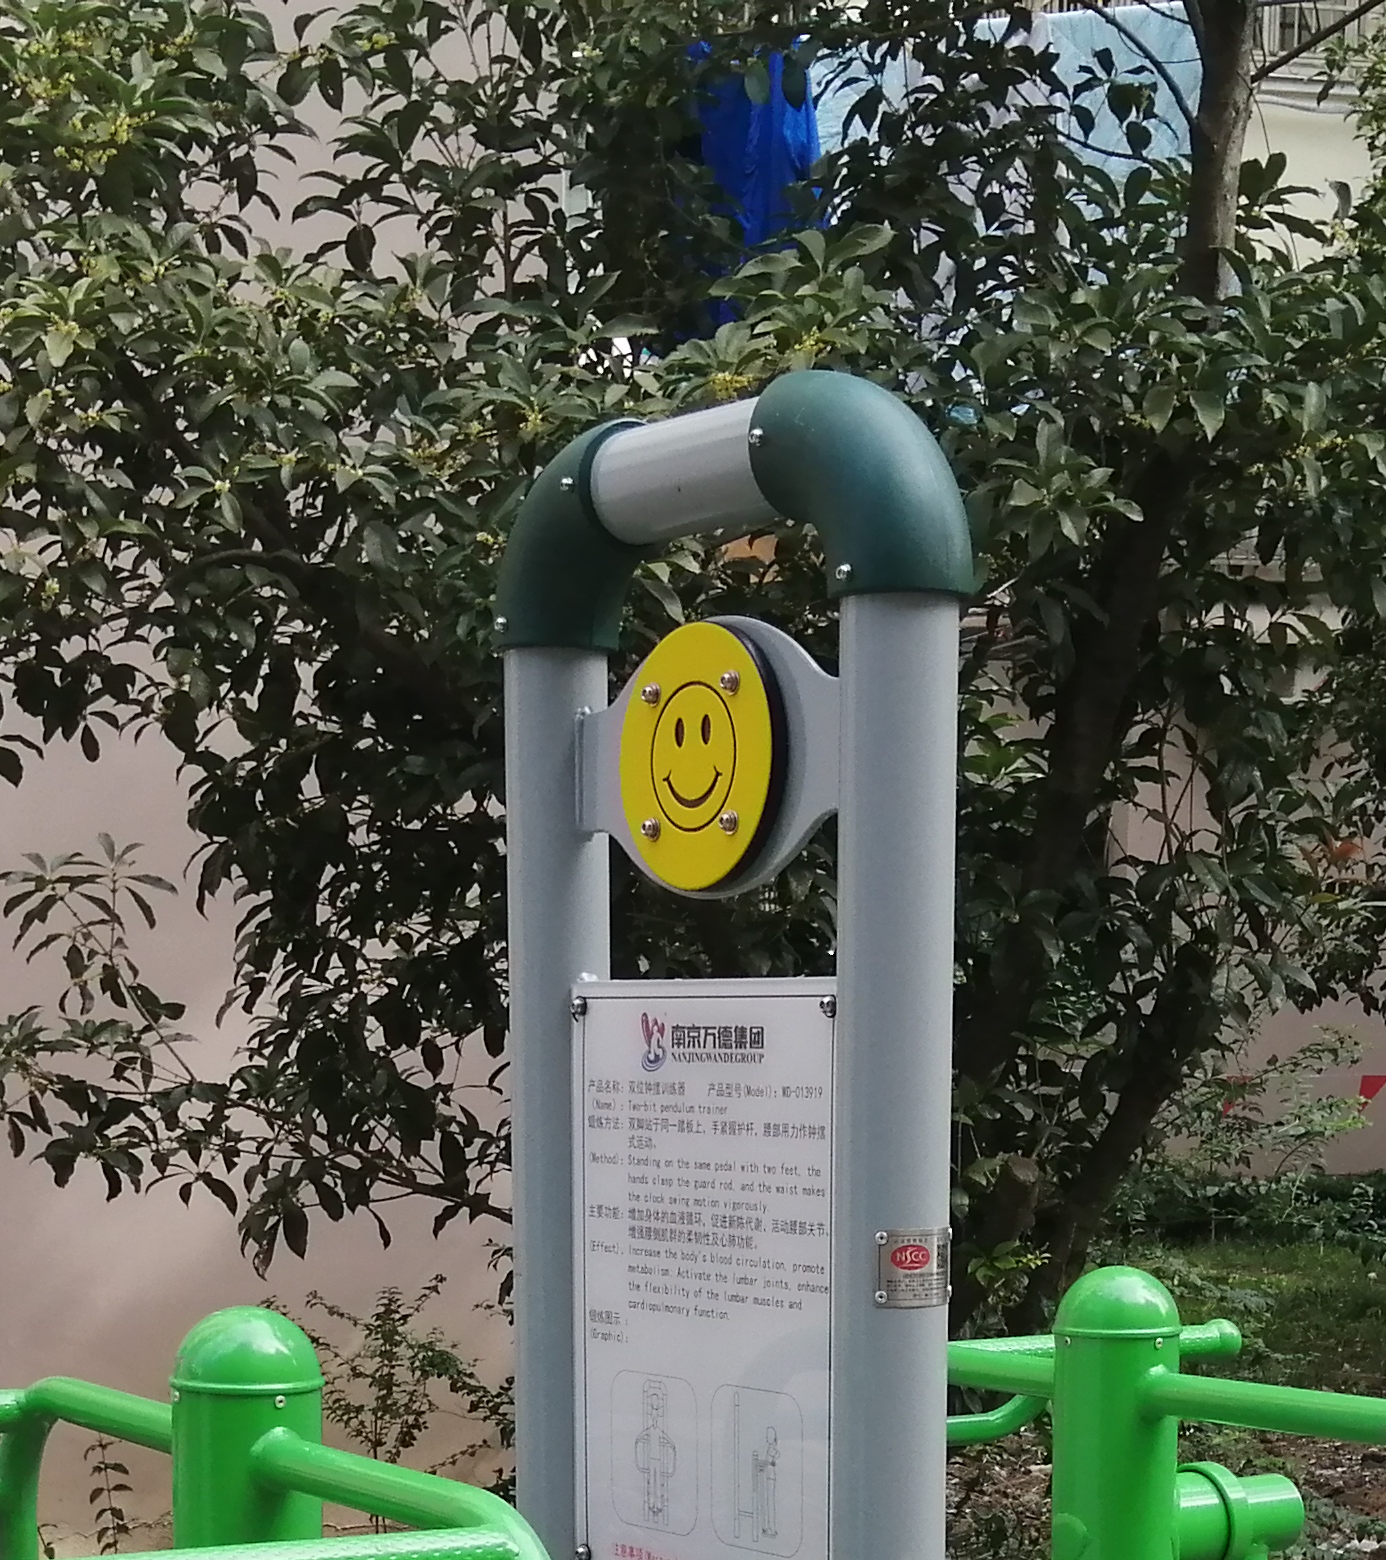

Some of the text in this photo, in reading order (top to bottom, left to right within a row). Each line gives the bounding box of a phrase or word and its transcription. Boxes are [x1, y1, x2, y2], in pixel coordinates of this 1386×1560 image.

[671, 1023, 764, 1050] 南京万德集团
[671, 1052, 765, 1064] NANJINGWANDEGROUP
[660, 1103, 695, 1114] pendulum
[698, 1104, 728, 1116] trainer
[627, 1154, 661, 1169] Standing
[664, 1160, 674, 1168] on
[677, 1157, 690, 1169] the
[694, 1161, 711, 1170] same
[714, 1160, 736, 1173] pedal
[740, 1161, 759, 1173] with
[763, 1163, 776, 1175] two
[807, 1164, 821, 1177] the
[627, 1172, 649, 1185] hands
[652, 1174, 674, 1188] clasp
[677, 1176, 690, 1188] the
[694, 1178, 716, 1191] guard
[740, 1180, 754, 1192] and
[758, 1180, 772, 1193] the
[776, 1183, 798, 1195] waist
[628, 1191, 641, 1202] the
[629, 1244, 661, 1259] Increase
[665, 1247, 678, 1260] the
[710, 1251, 733, 1265] blood
[792, 1261, 825, 1275] promote
[896, 1247, 927, 1265] NSCC
[677, 1266, 712, 1281] Activate
[715, 1270, 728, 1283] the
[797, 1280, 829, 1295] enhance
[628, 1280, 641, 1292] the
[644, 1281, 690, 1299] flexibility
[694, 1287, 703, 1299] of
[706, 1288, 719, 1301] the
[788, 1298, 802, 1311] and
